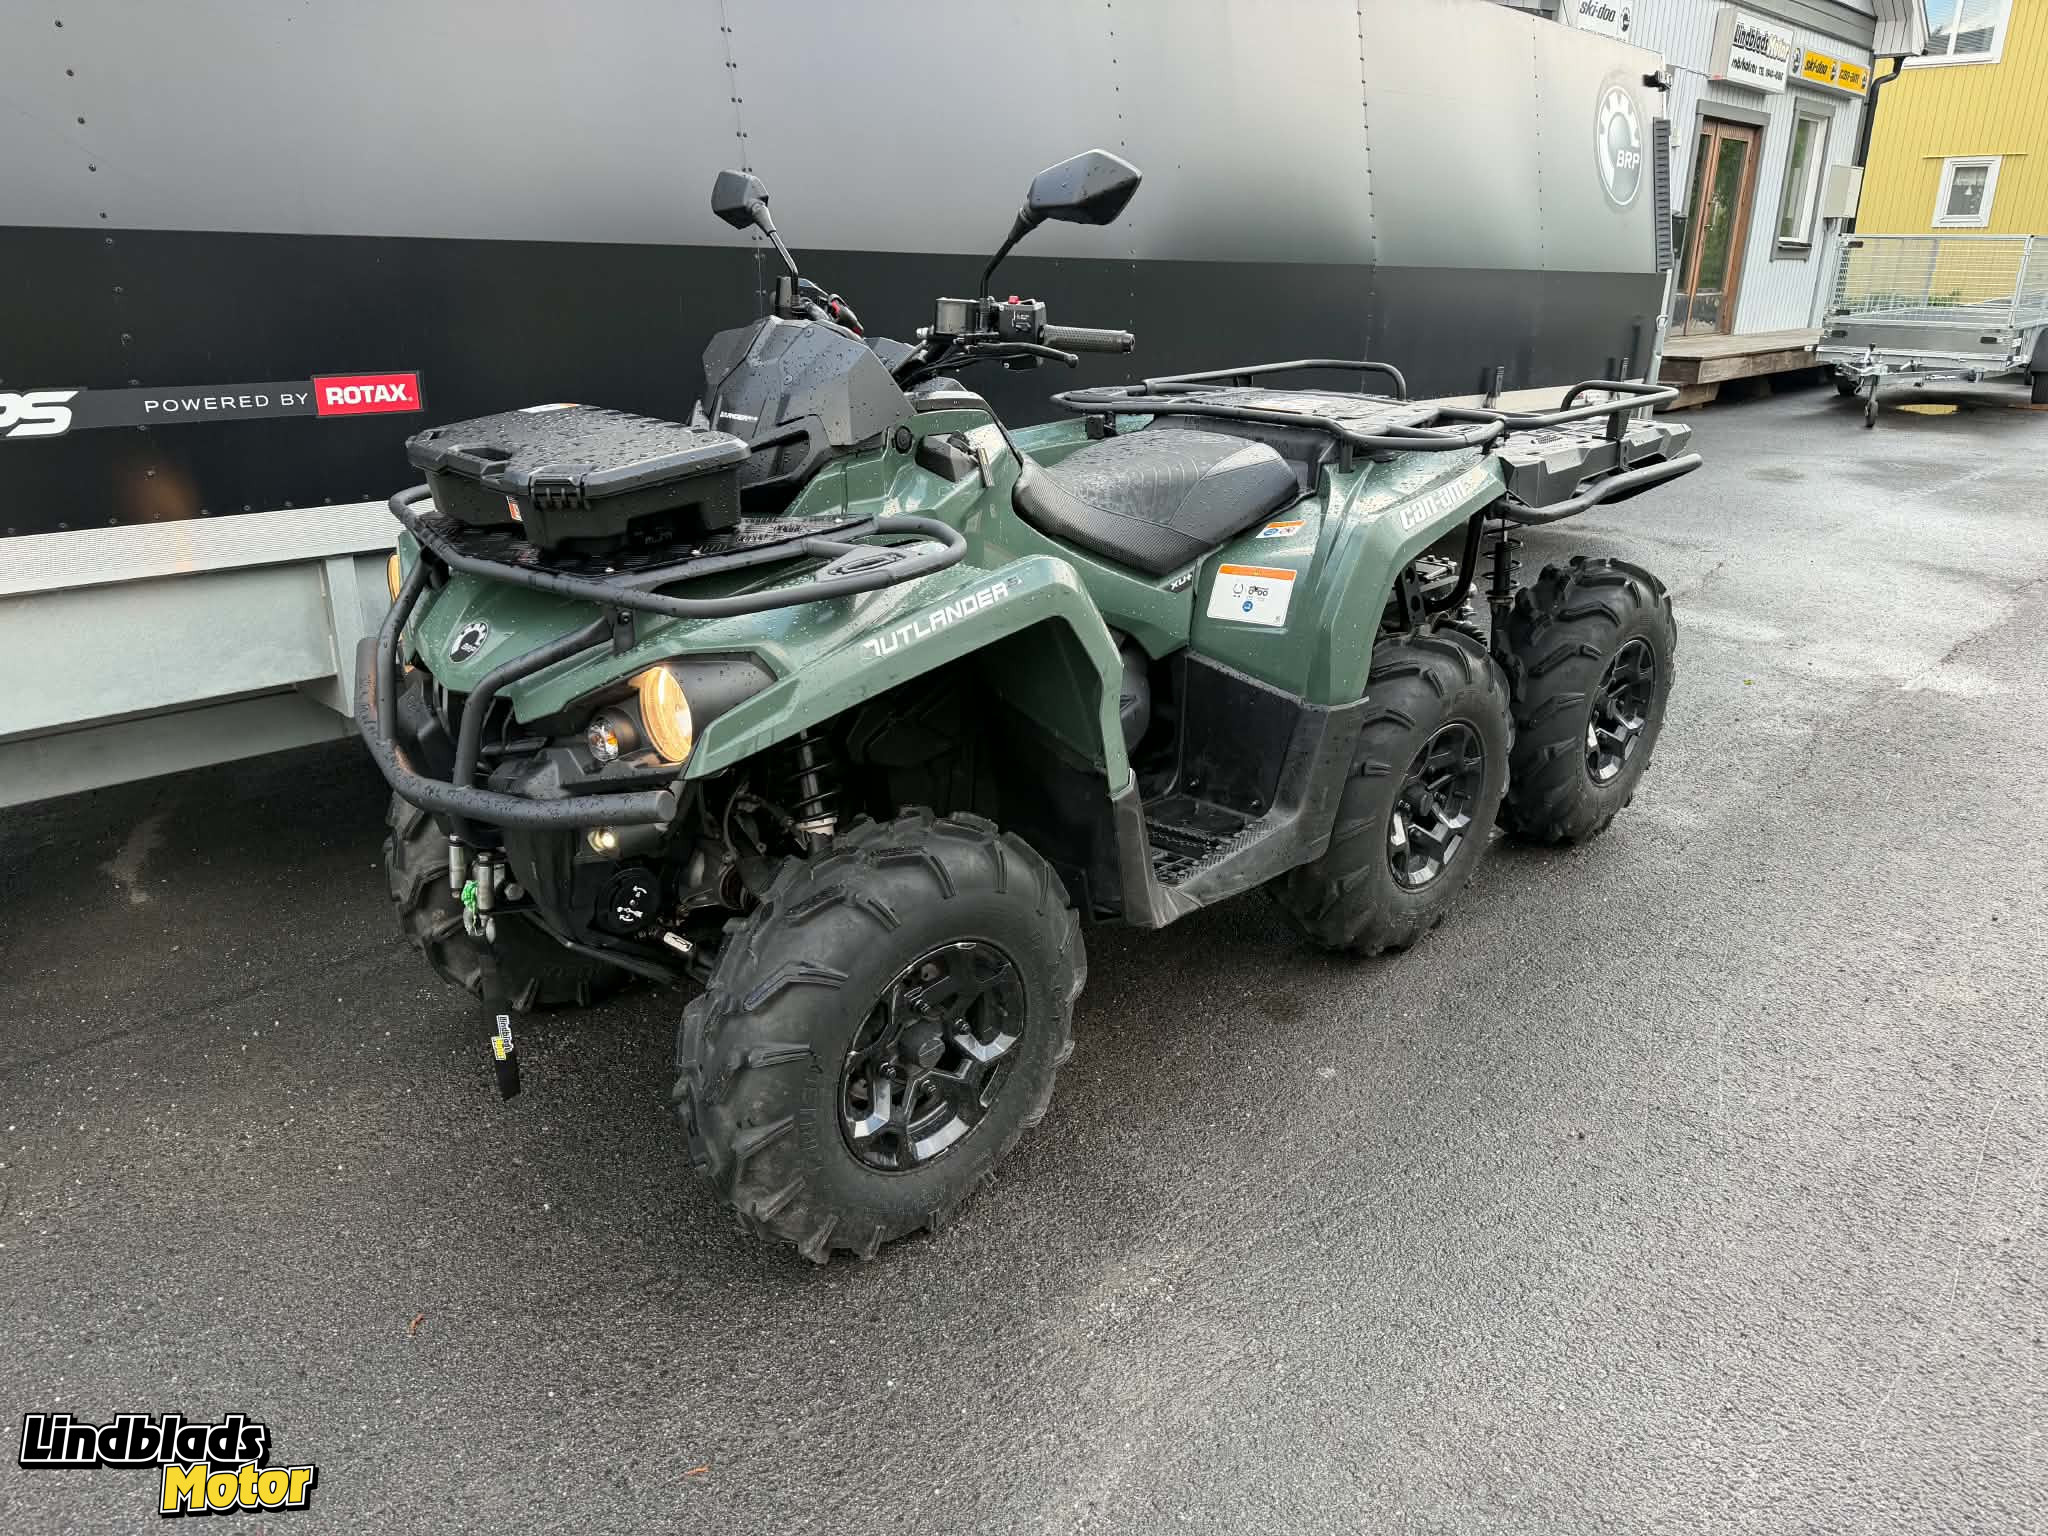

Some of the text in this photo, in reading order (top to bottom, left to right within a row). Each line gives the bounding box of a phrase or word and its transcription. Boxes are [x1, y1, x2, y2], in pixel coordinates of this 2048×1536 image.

[1579, 0, 1616, 22] ski-doo
[1616, 150, 1640, 169] BRP
[144, 383, 406, 413] POWERED BY ROTAX
